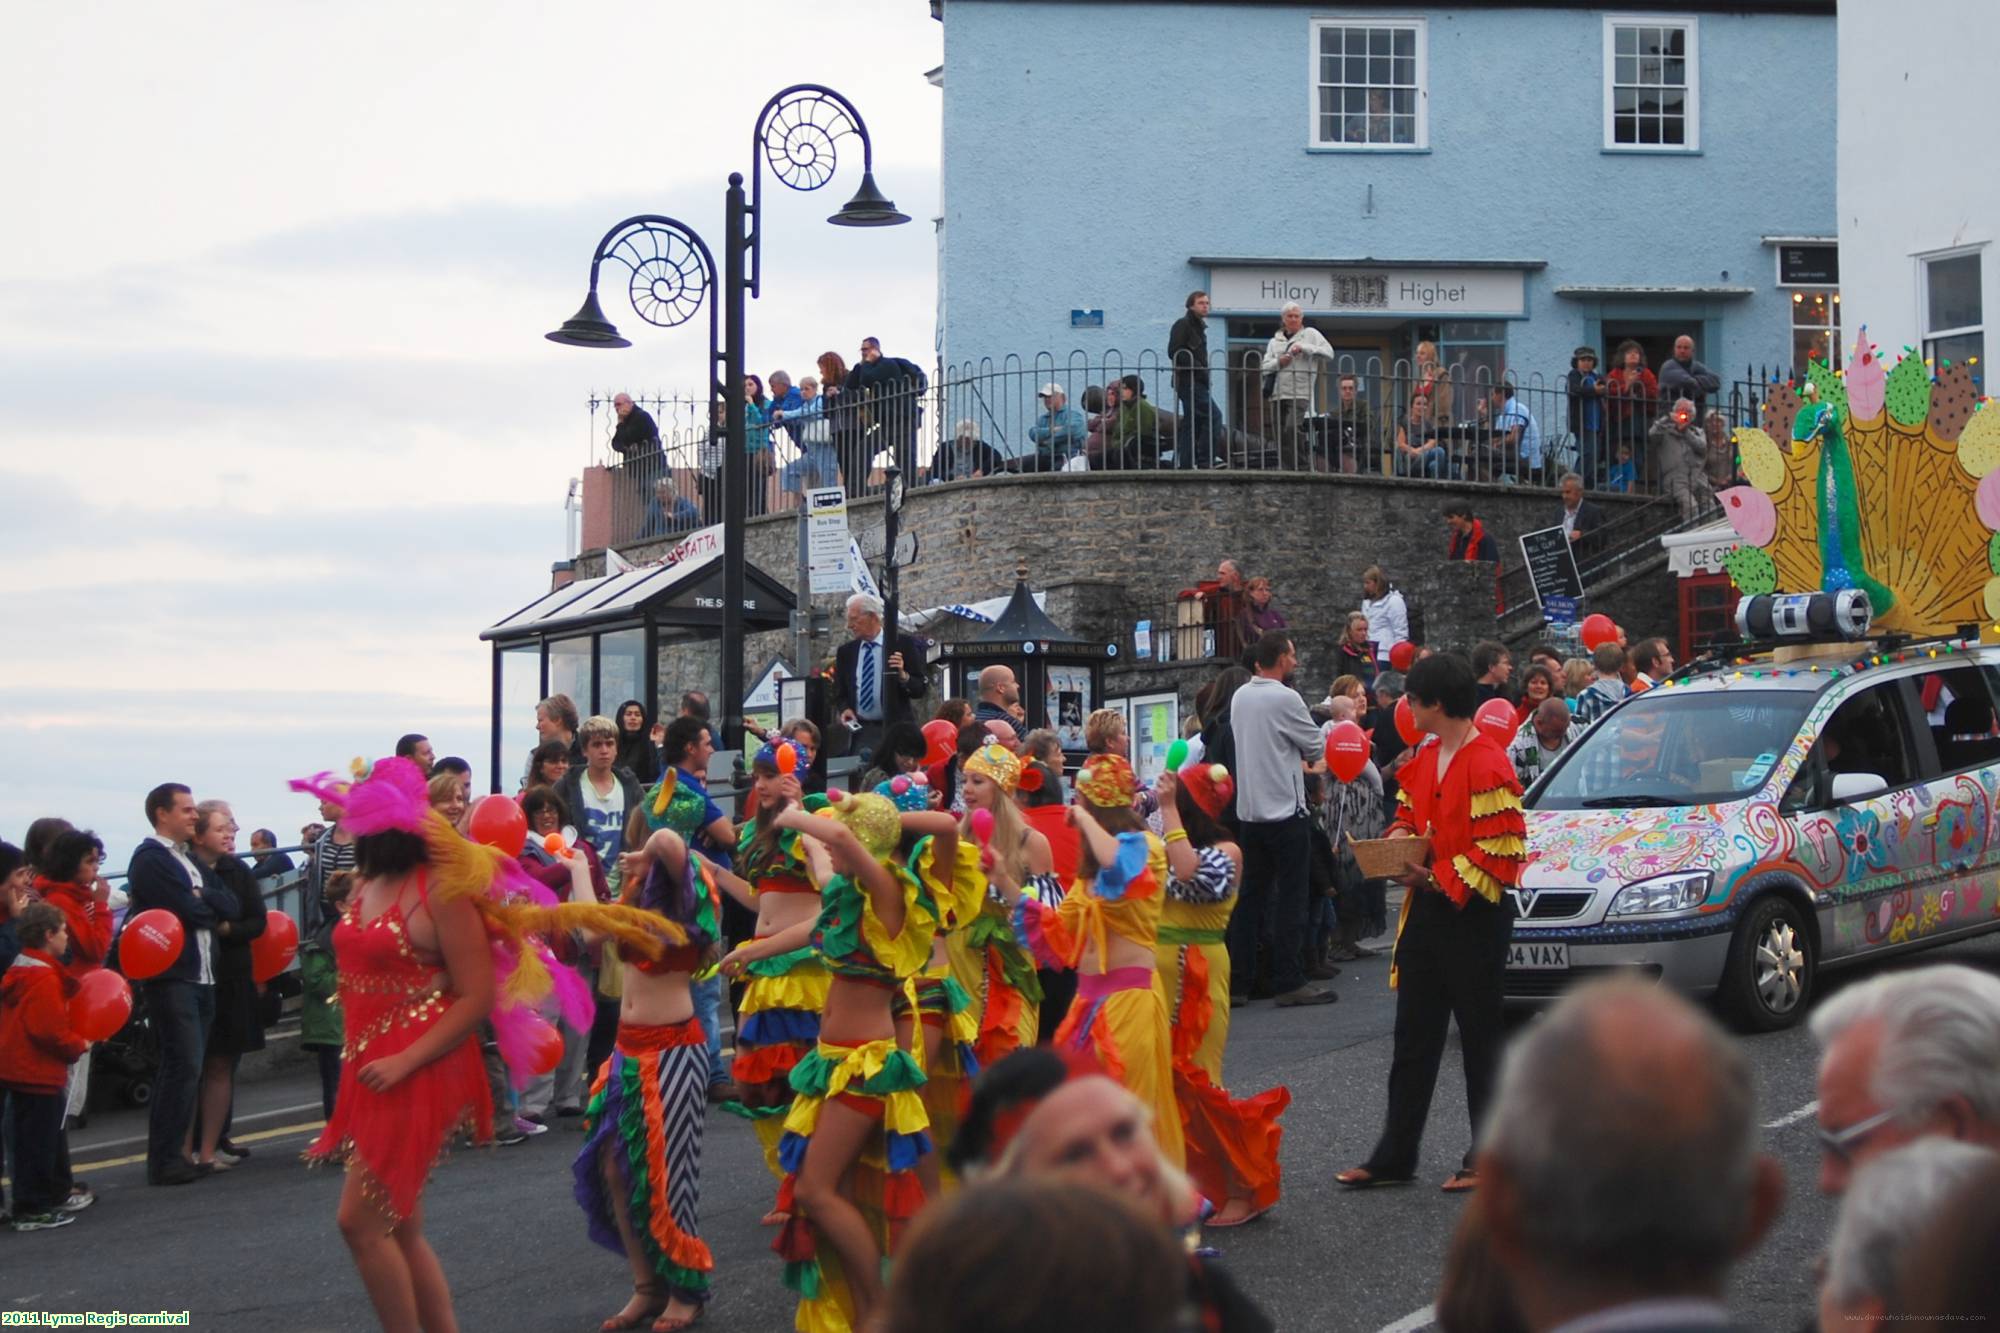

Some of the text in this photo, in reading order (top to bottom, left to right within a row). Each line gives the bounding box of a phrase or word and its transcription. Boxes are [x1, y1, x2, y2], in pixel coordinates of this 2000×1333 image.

[1261, 280, 1319, 304] Hilary
[1400, 281, 1466, 305] Highet
[1689, 549, 1709, 566] ICE
[695, 597, 756, 610] THE SRE
[1529, 946, 1564, 965] VAX
